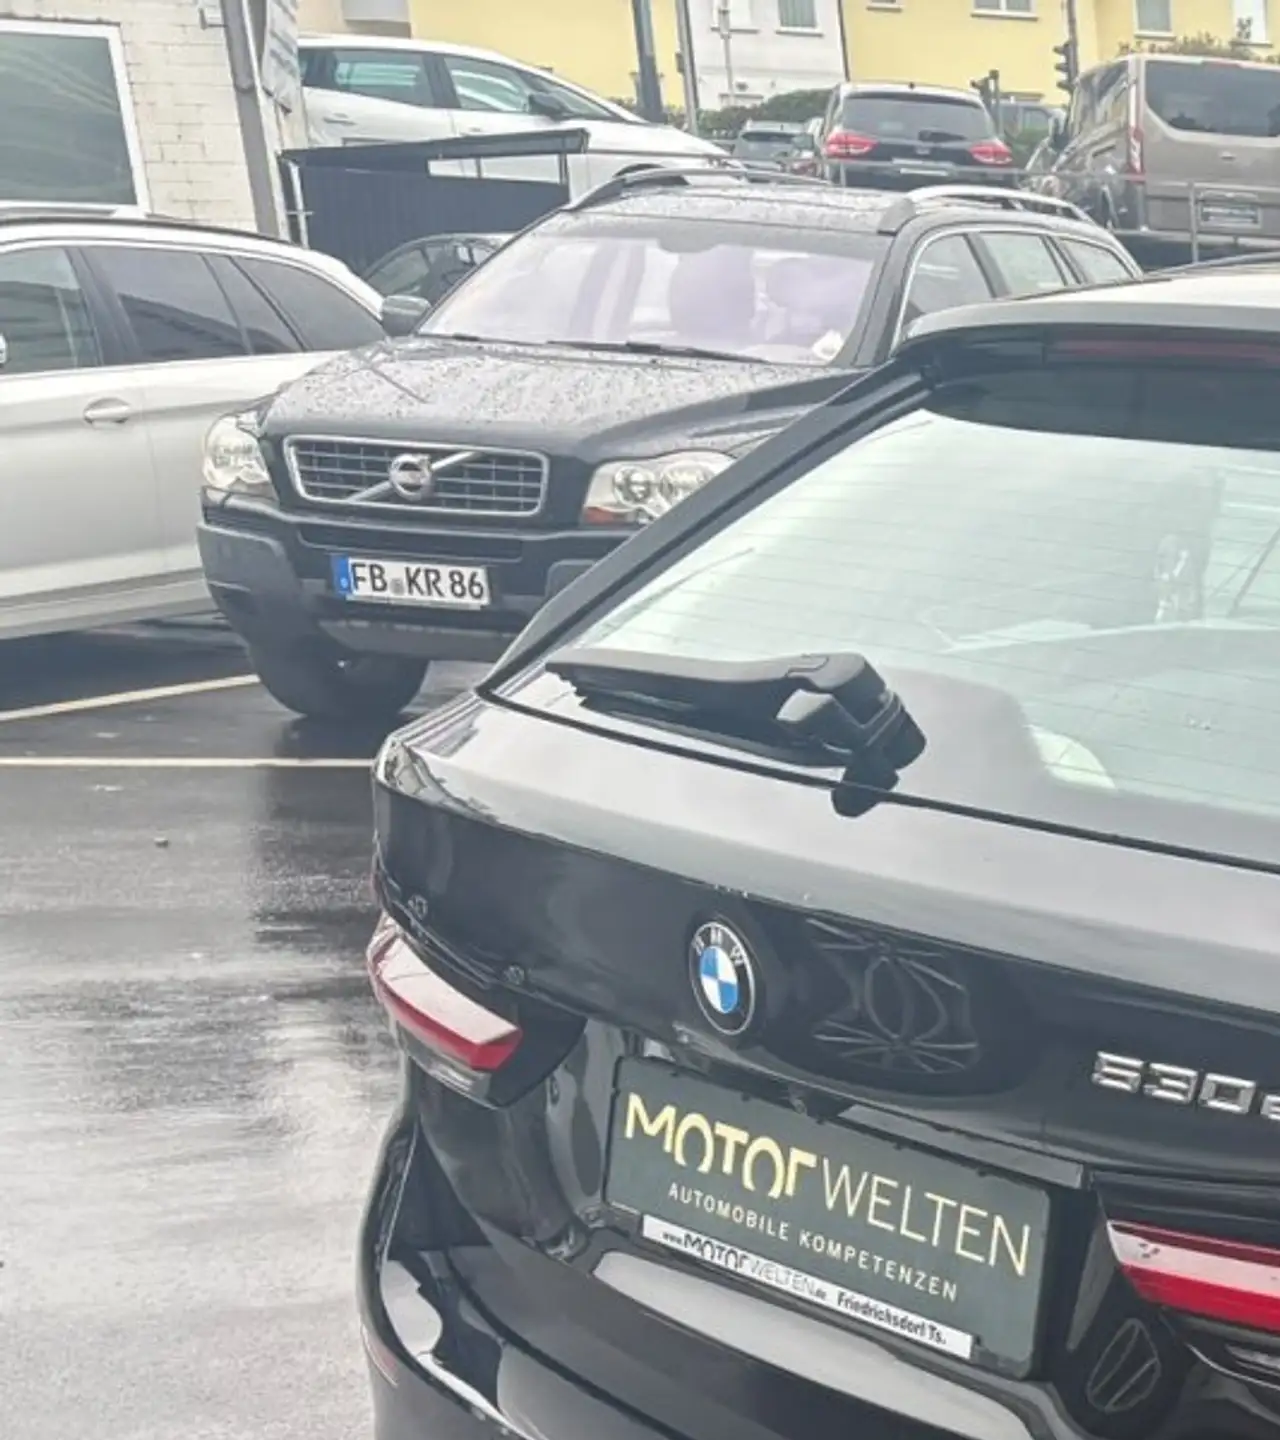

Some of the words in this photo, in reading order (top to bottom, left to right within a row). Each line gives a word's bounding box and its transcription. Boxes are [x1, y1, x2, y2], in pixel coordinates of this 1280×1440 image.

[351, 562, 389, 593] FB
[405, 566, 446, 598] KR
[448, 569, 485, 600] 86
[667, 1181, 791, 1242] AUTOMOBILE
[799, 1228, 958, 1303] KOMPETENZEN
[837, 1289, 927, 1338] Friedrichsdorf
